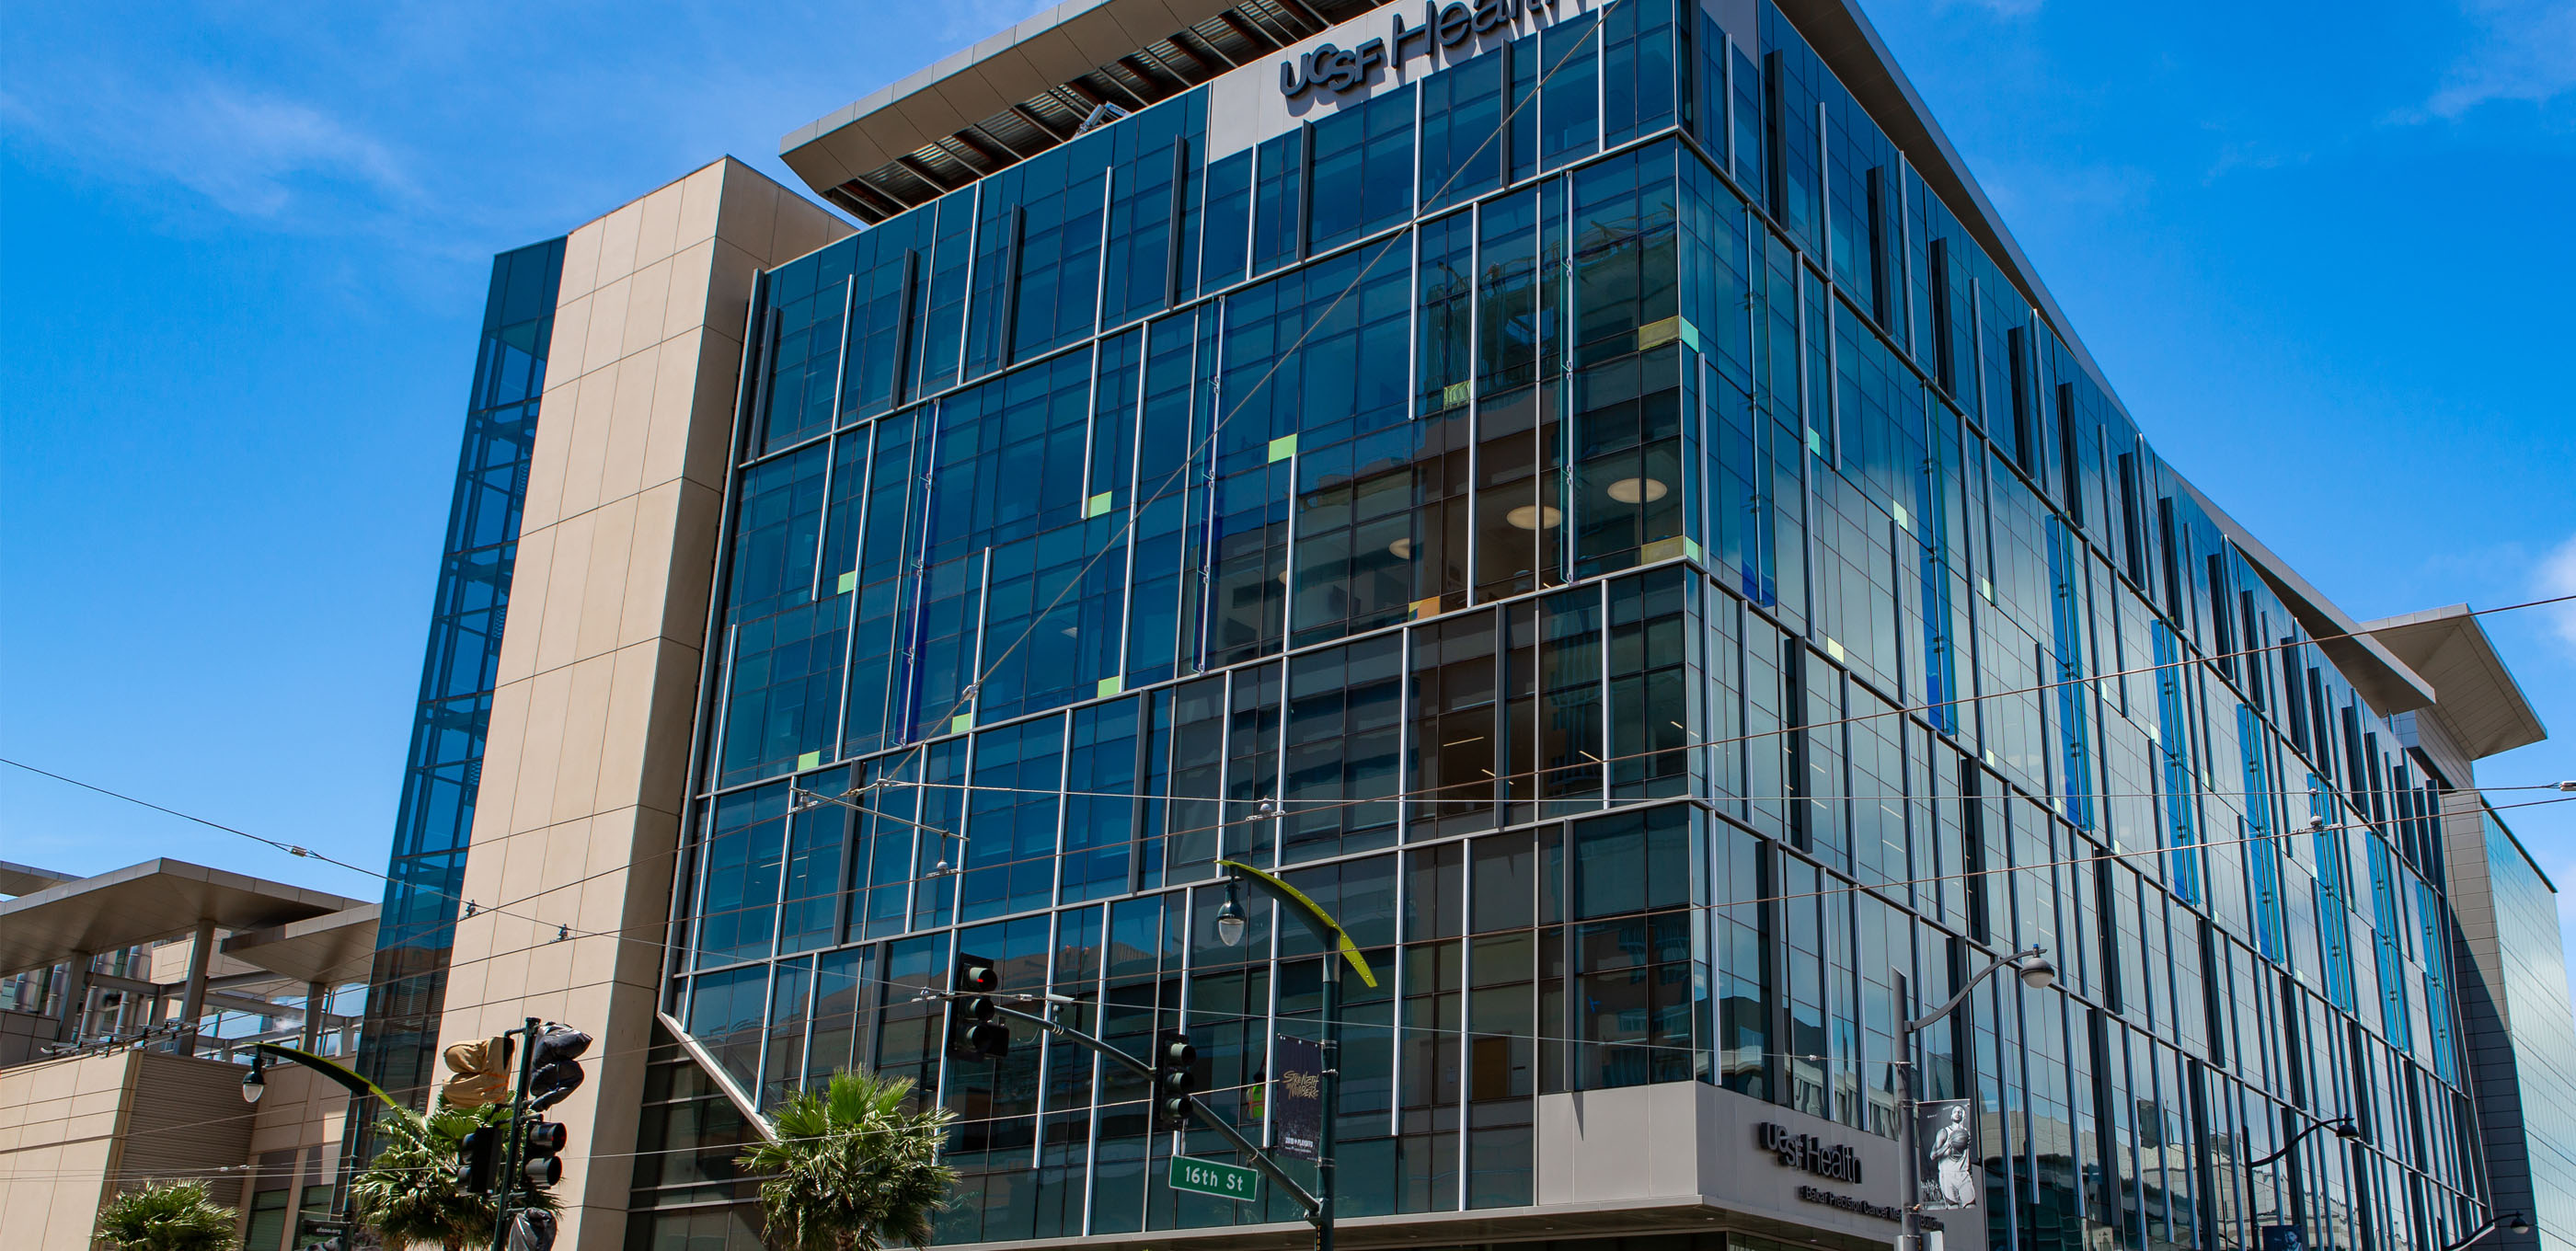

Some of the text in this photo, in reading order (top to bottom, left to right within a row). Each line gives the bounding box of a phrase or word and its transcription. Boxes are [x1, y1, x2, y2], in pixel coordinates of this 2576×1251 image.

[1280, 37, 1383, 96] UCSF
[1760, 1121, 1862, 1184] UCSF Health
[1186, 1165, 1244, 1191] 16th St
[1829, 1193, 1862, 1212] Precision
[1862, 1200, 1890, 1219] Cancer
